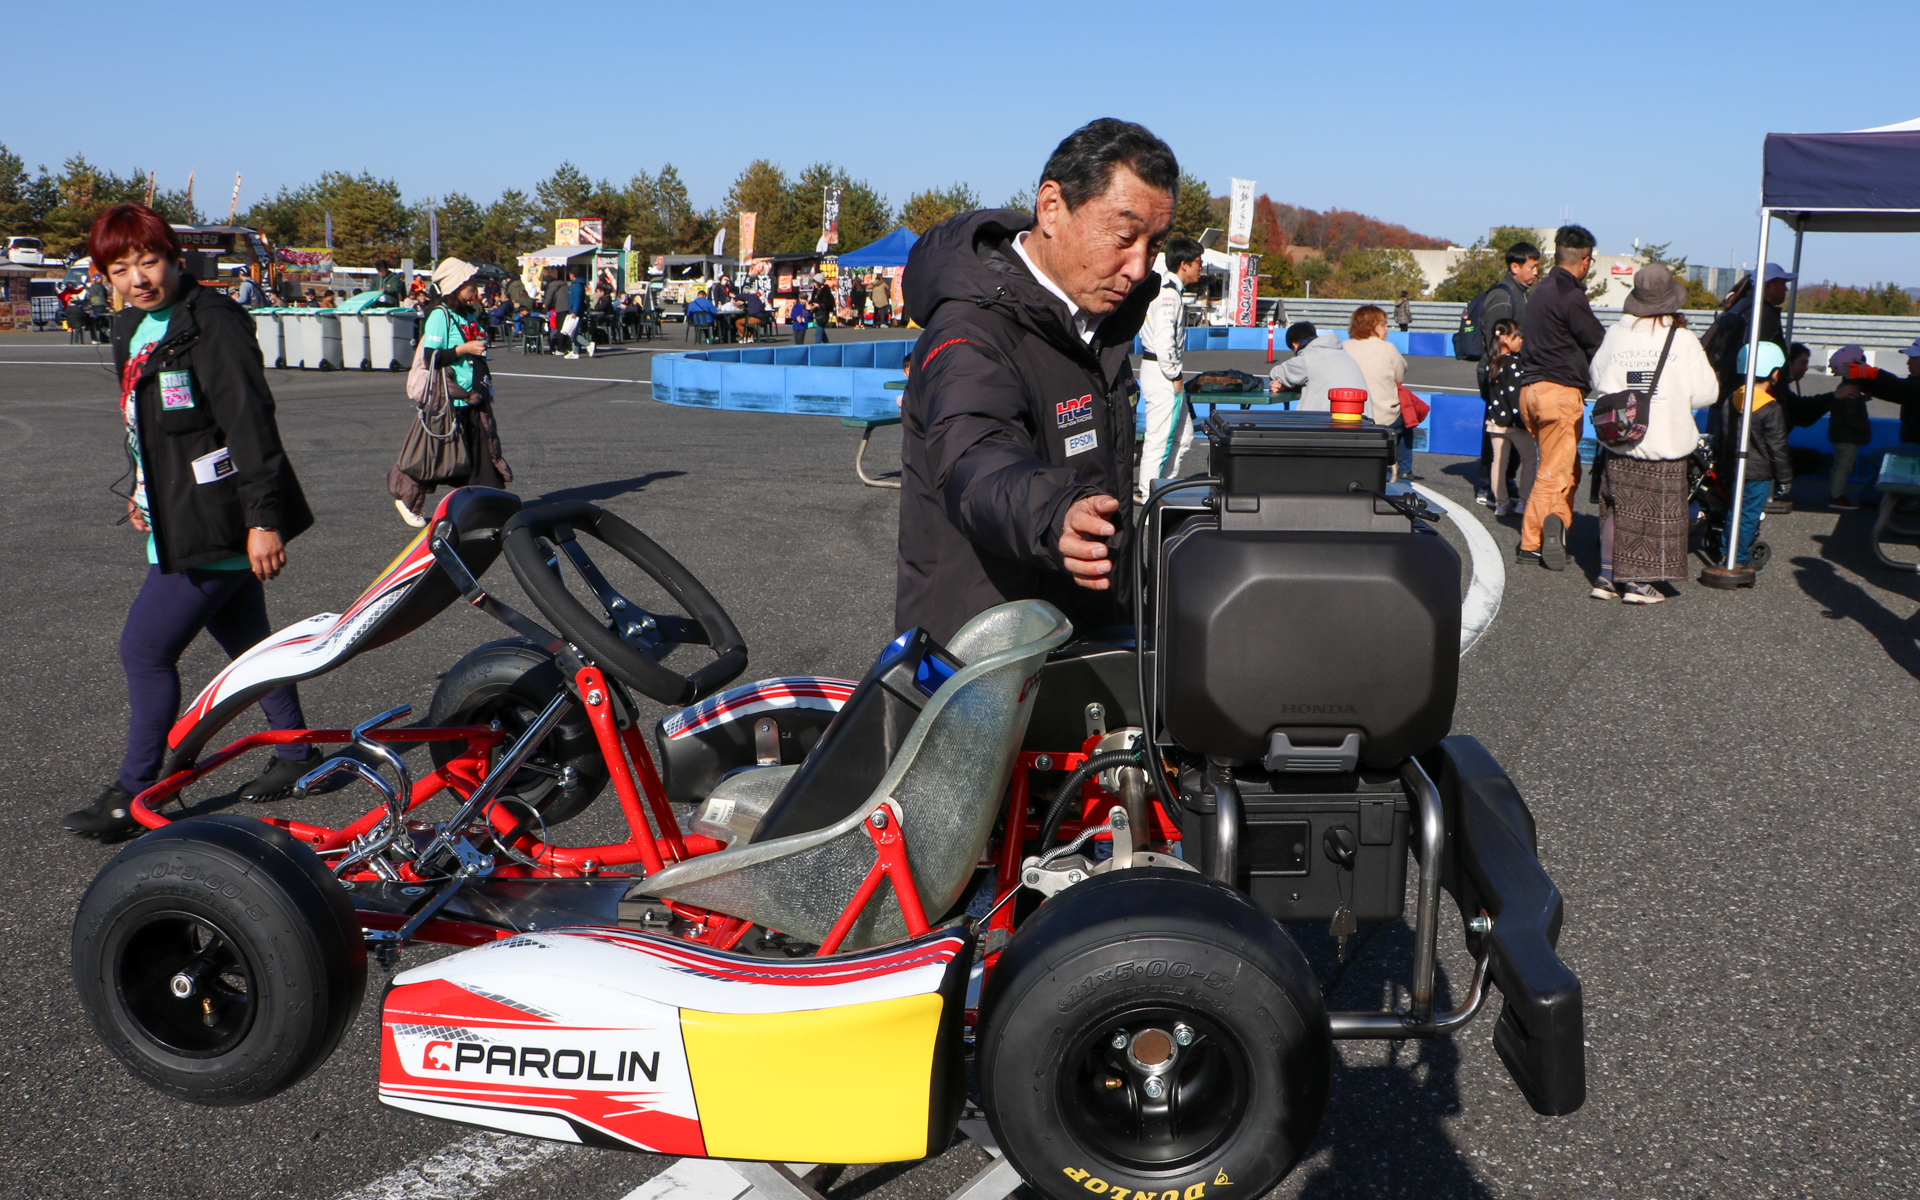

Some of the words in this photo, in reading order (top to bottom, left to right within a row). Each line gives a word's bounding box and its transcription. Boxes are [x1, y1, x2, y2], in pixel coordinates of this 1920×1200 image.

[1648, 349, 1679, 363] COST
[161, 372, 188, 388] STAFF
[1056, 394, 1092, 425] HRC
[1070, 433, 1094, 449] EPSON
[1280, 703, 1358, 714] HONDA
[454, 1042, 661, 1082] PAROLIN
[1062, 1166, 1207, 1200] DUNLOP
